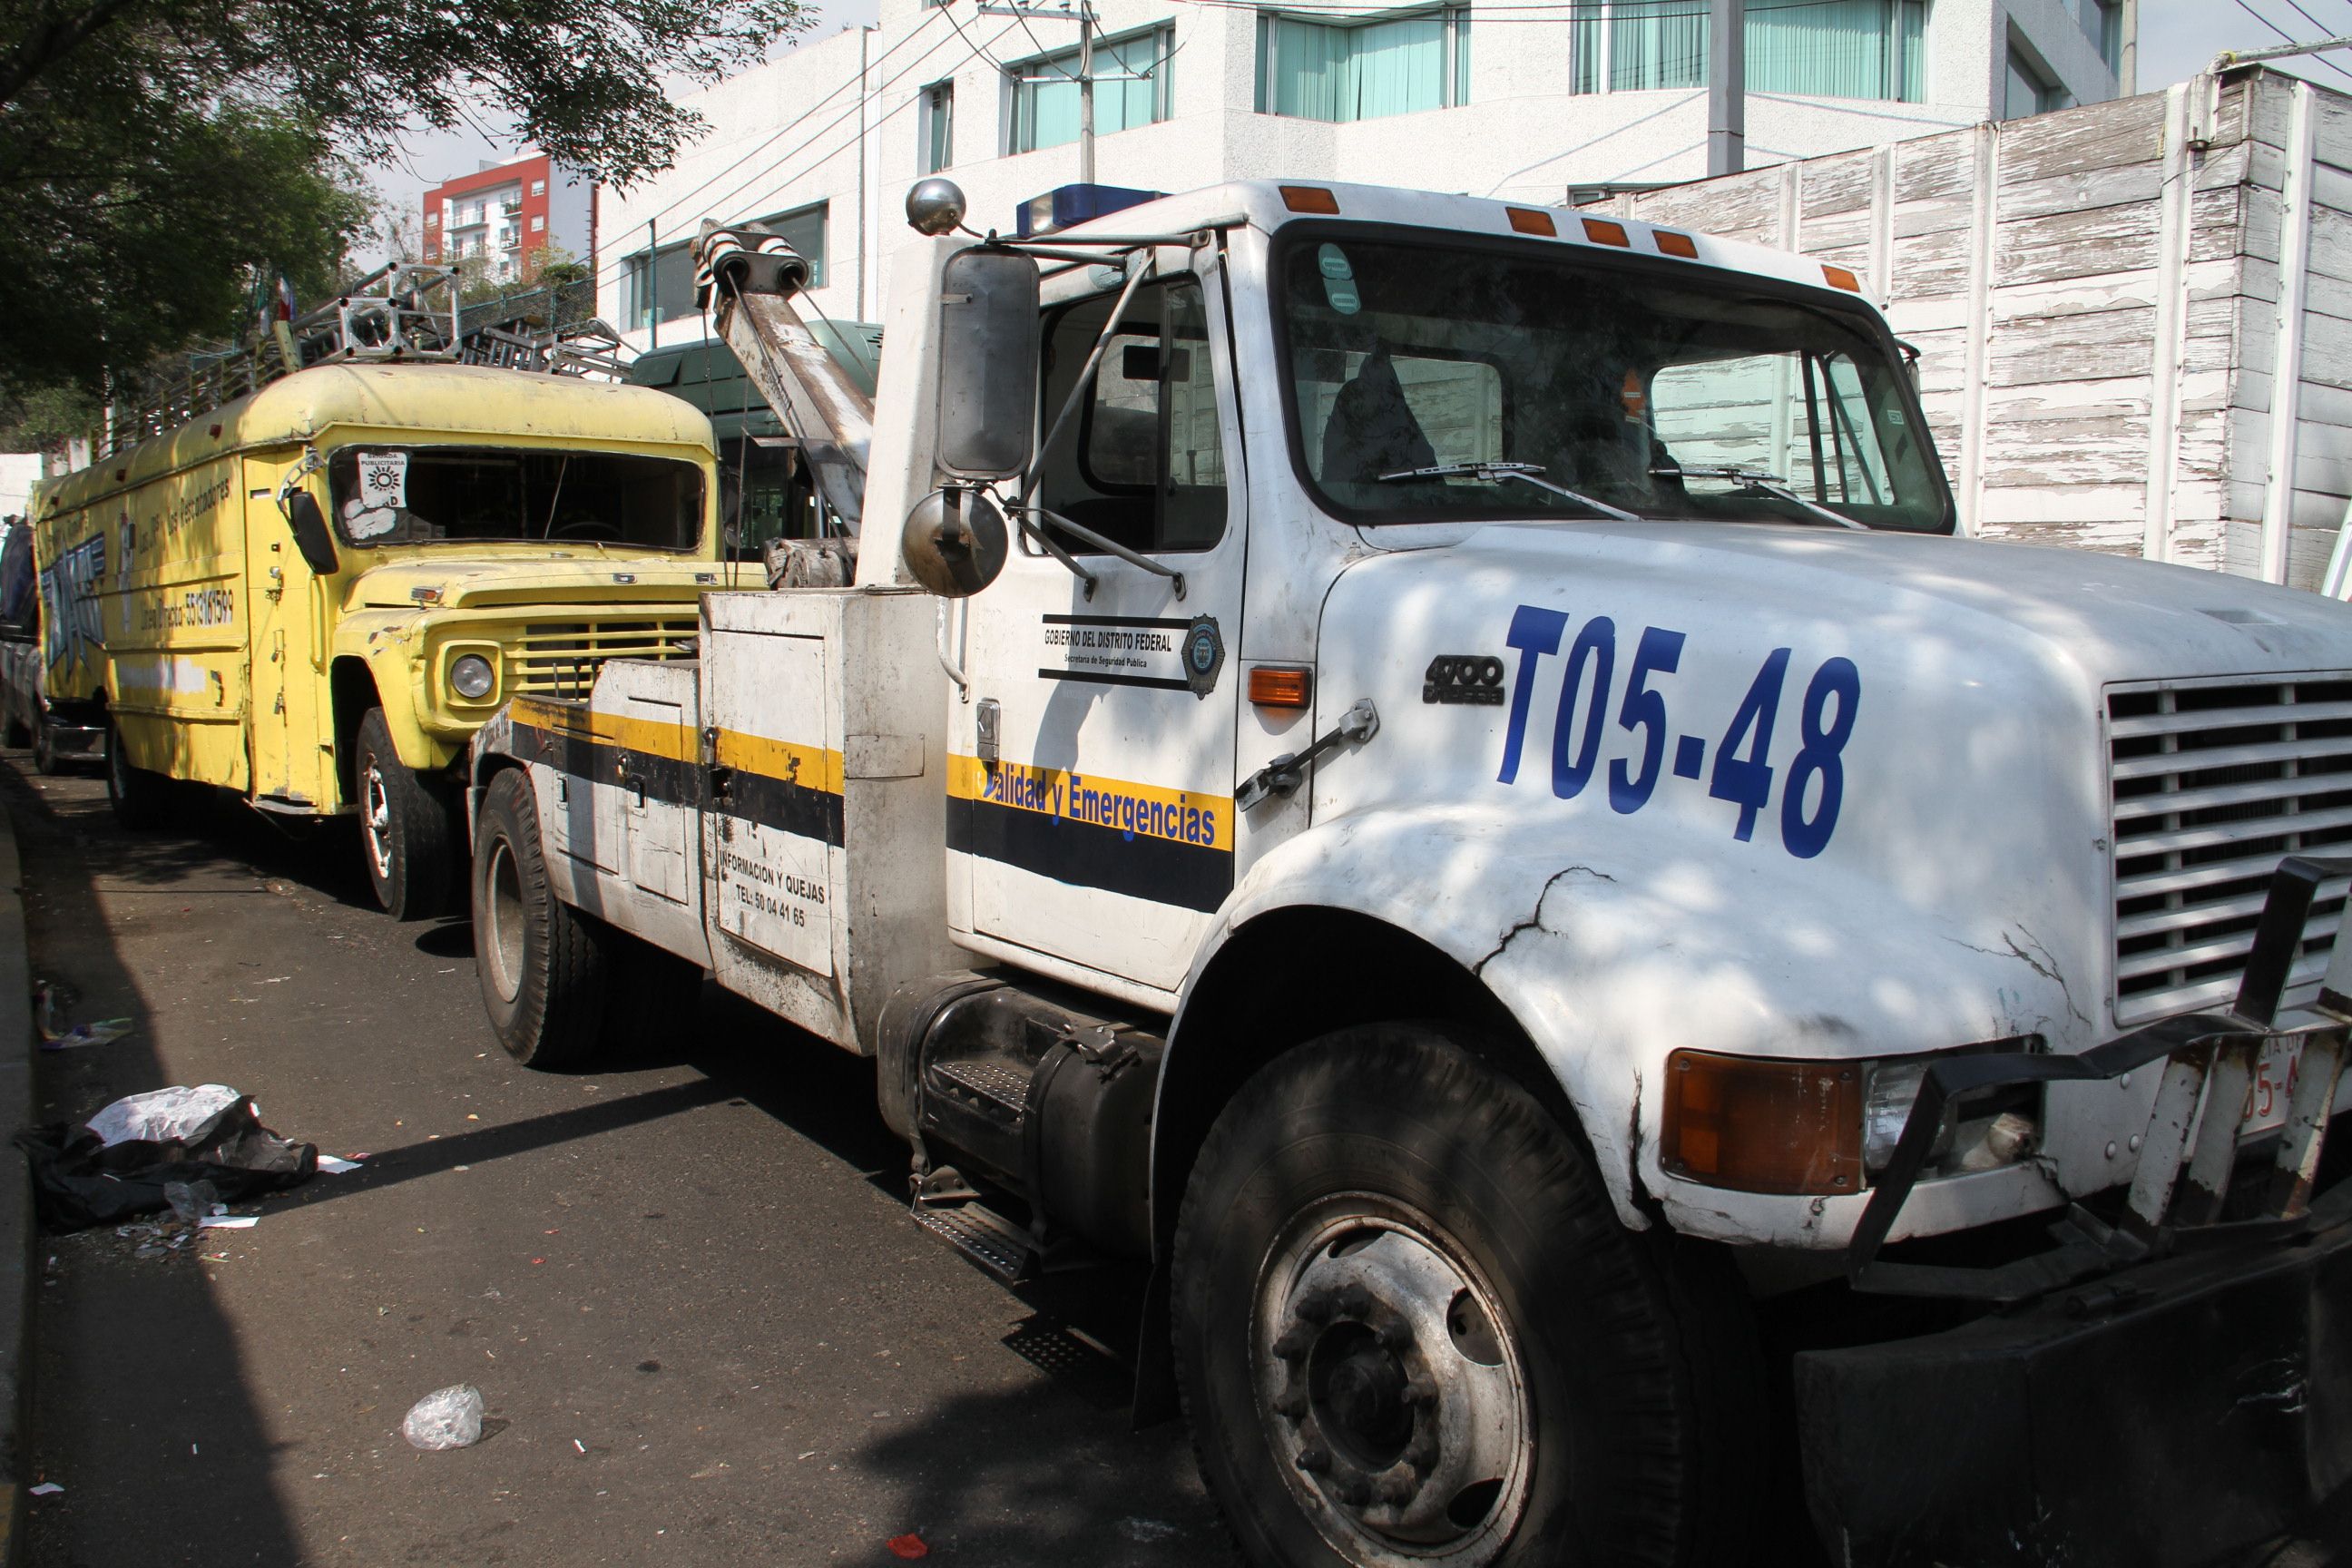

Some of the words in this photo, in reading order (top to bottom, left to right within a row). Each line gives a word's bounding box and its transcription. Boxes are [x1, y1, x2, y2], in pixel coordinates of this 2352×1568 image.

[1044, 629, 1081, 647] GOBIERNO
[1082, 631, 1096, 648] DEL
[1097, 632, 1133, 650] DISTRITO
[1134, 633, 1171, 652] FEDERAL
[1091, 654, 1097, 664] de
[1099, 655, 1125, 668] Seguridad
[1496, 604, 1861, 858] T05-48
[1053, 783, 1063, 827] y
[1069, 775, 1215, 845] Emergencias
[720, 850, 774, 887] INFORMACION
[777, 870, 783, 889] Y
[786, 875, 825, 905] QUEJAS
[755, 892, 765, 911] 50
[767, 897, 778, 918] 04
[779, 904, 790, 922] 41
[793, 908, 805, 927] 65
